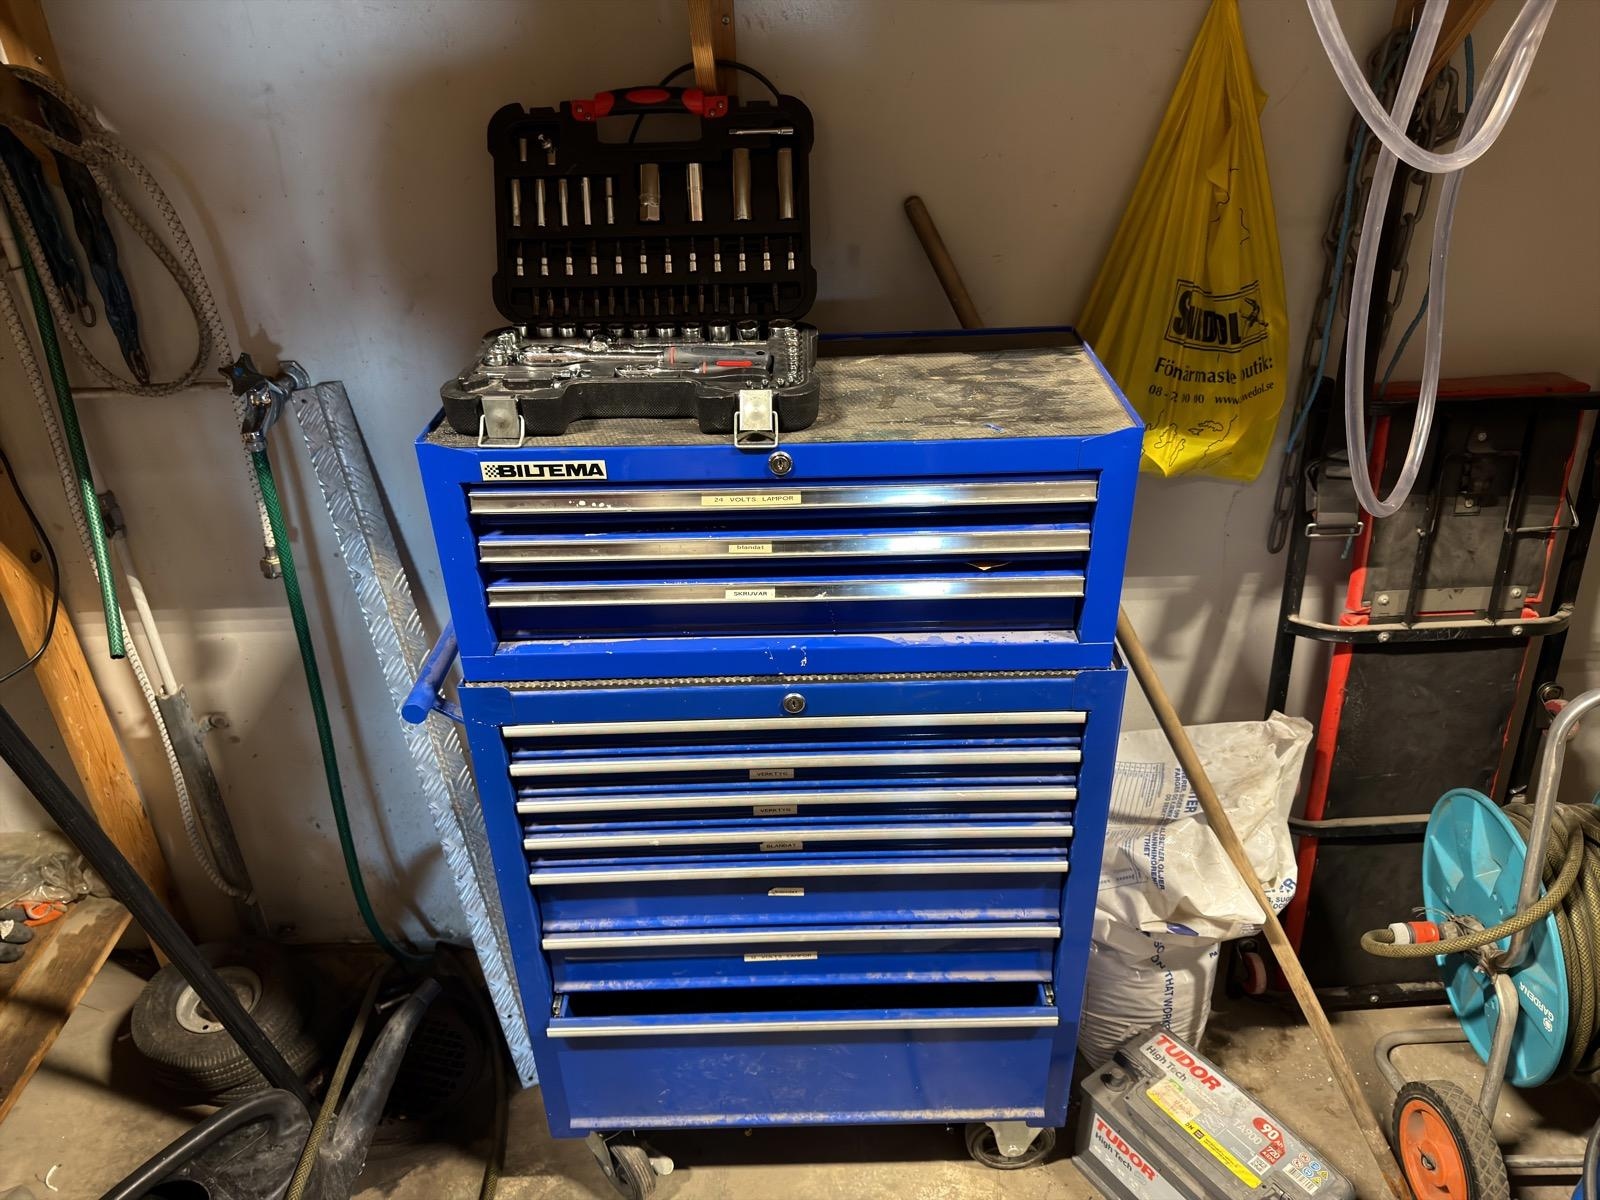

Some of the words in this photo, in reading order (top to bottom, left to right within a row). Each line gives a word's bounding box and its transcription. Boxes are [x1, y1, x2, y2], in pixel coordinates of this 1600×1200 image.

[1241, 355, 1273, 380] utik:
[497, 463, 605, 478] BILTEMA
[1157, 864, 1165, 890] OLJER
[1163, 970, 1174, 996] THAT
[1147, 1045, 1167, 1069] High
[1166, 1060, 1187, 1082] Tech
[1155, 1034, 1223, 1092] TUDOR
[1260, 1122, 1279, 1141] 90
[1094, 1131, 1116, 1157] High
[1114, 1150, 1134, 1172] Tech
[1096, 1117, 1158, 1182] TUDOR
